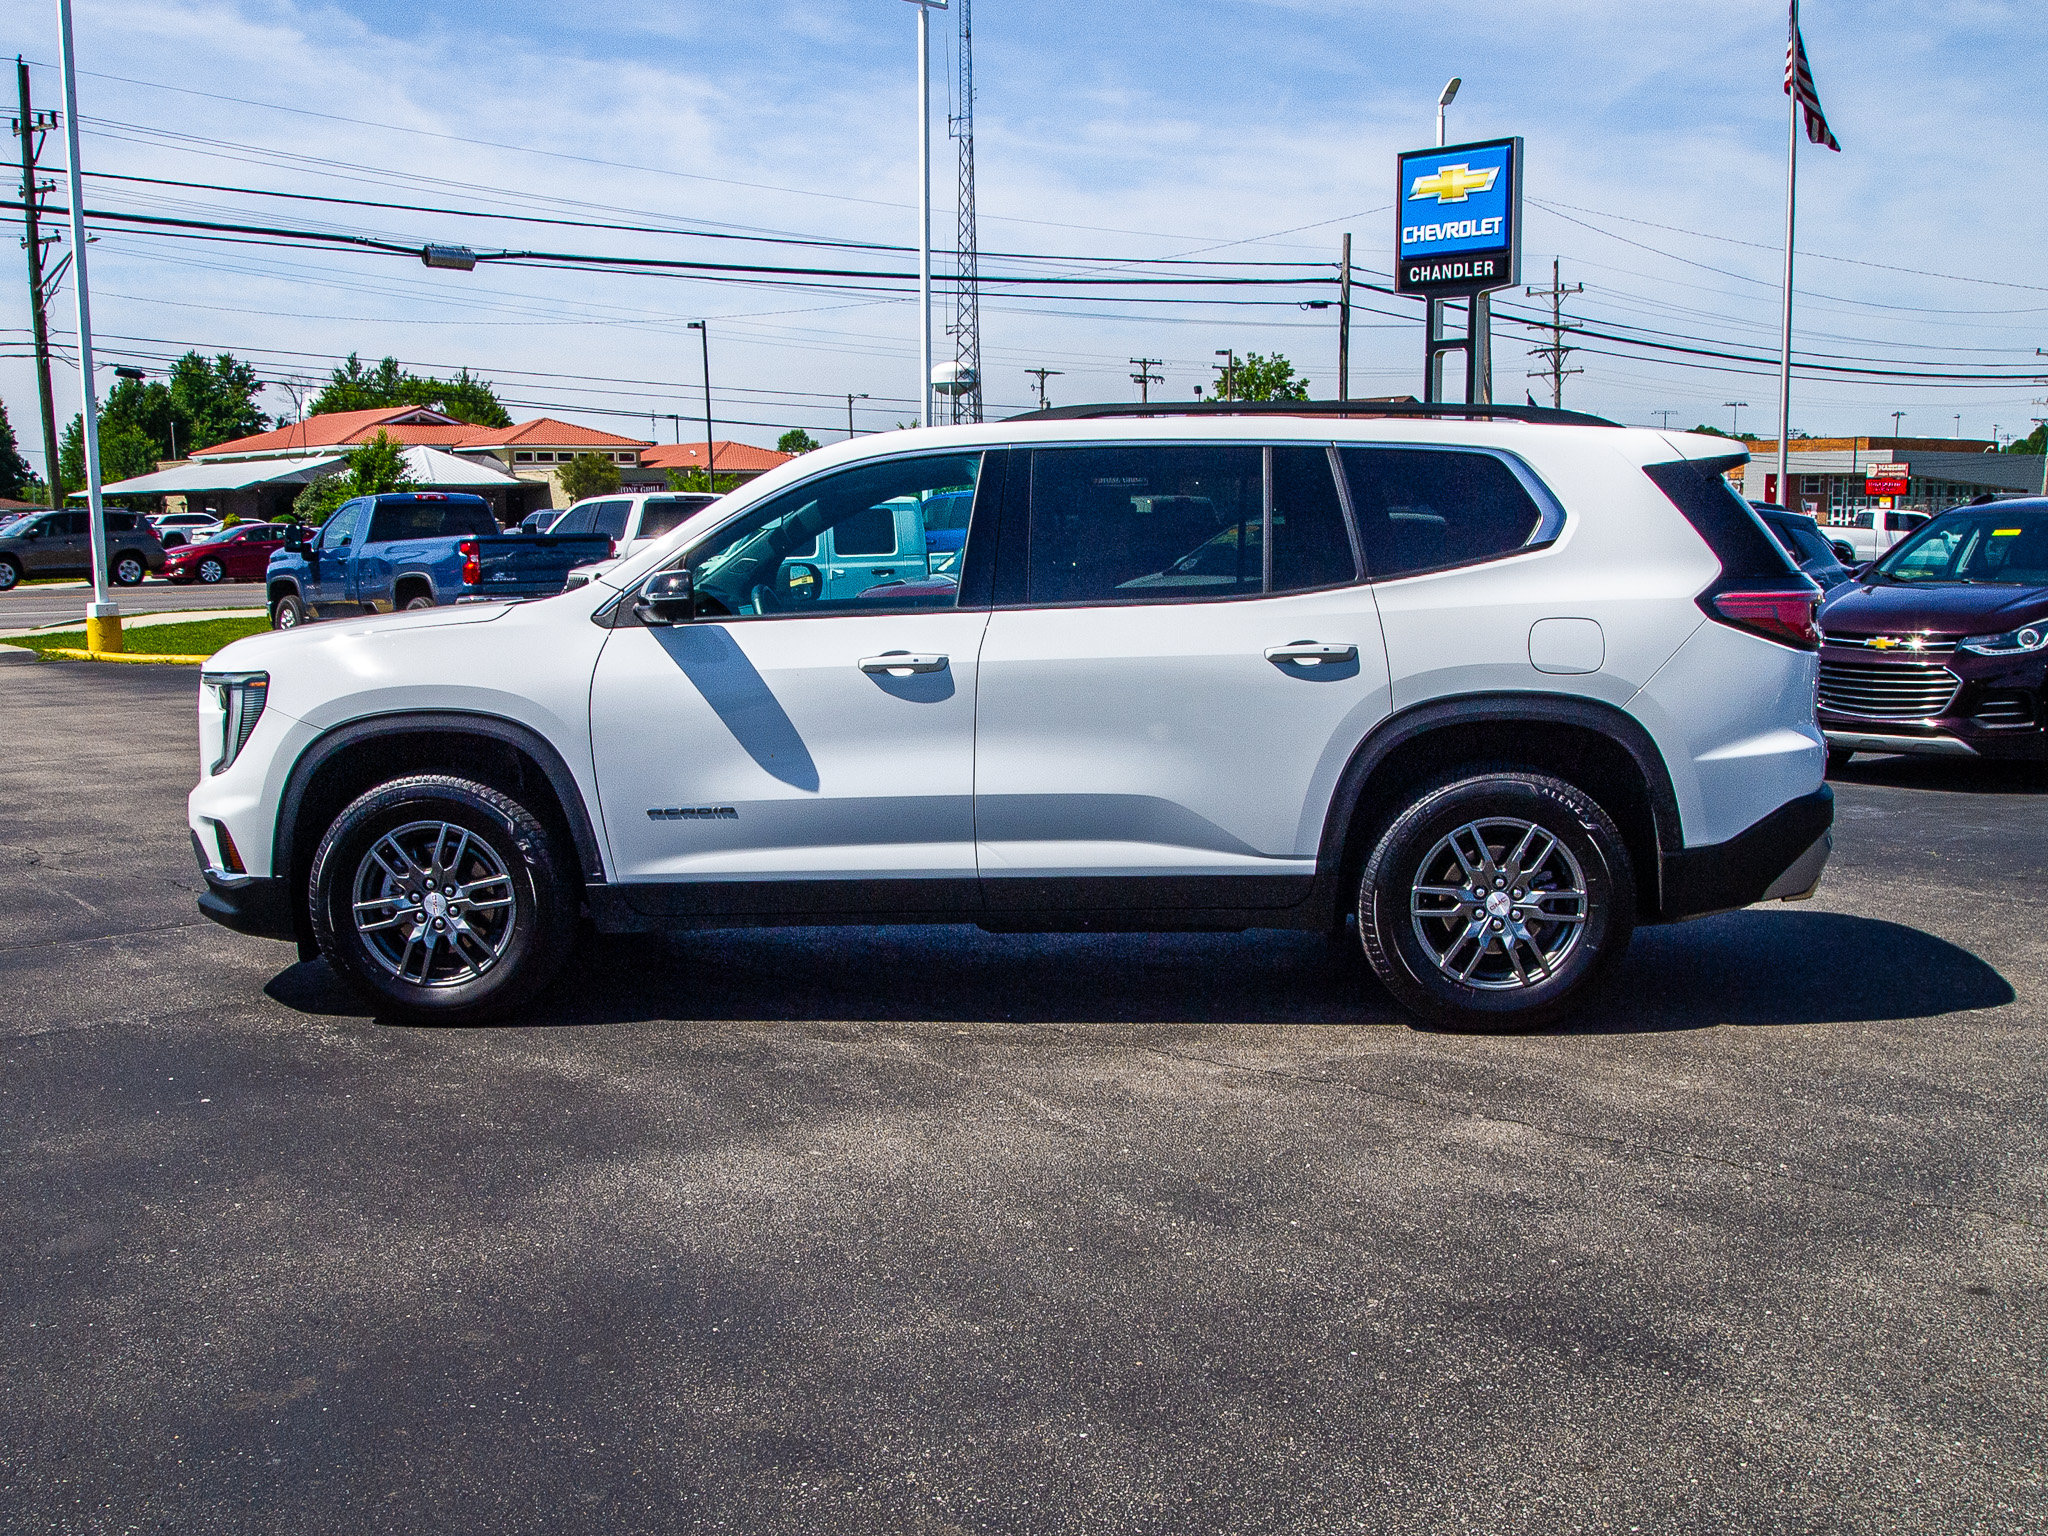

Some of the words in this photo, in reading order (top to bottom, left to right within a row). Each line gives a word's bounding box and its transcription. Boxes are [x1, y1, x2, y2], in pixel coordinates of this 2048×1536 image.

[1402, 216, 1503, 244] CHEVROLET
[1409, 260, 1494, 282] CHANDLER
[646, 806, 738, 819] ACADIA
[1541, 787, 1590, 821] ALENZA
[1489, 896, 1508, 911] GMC
